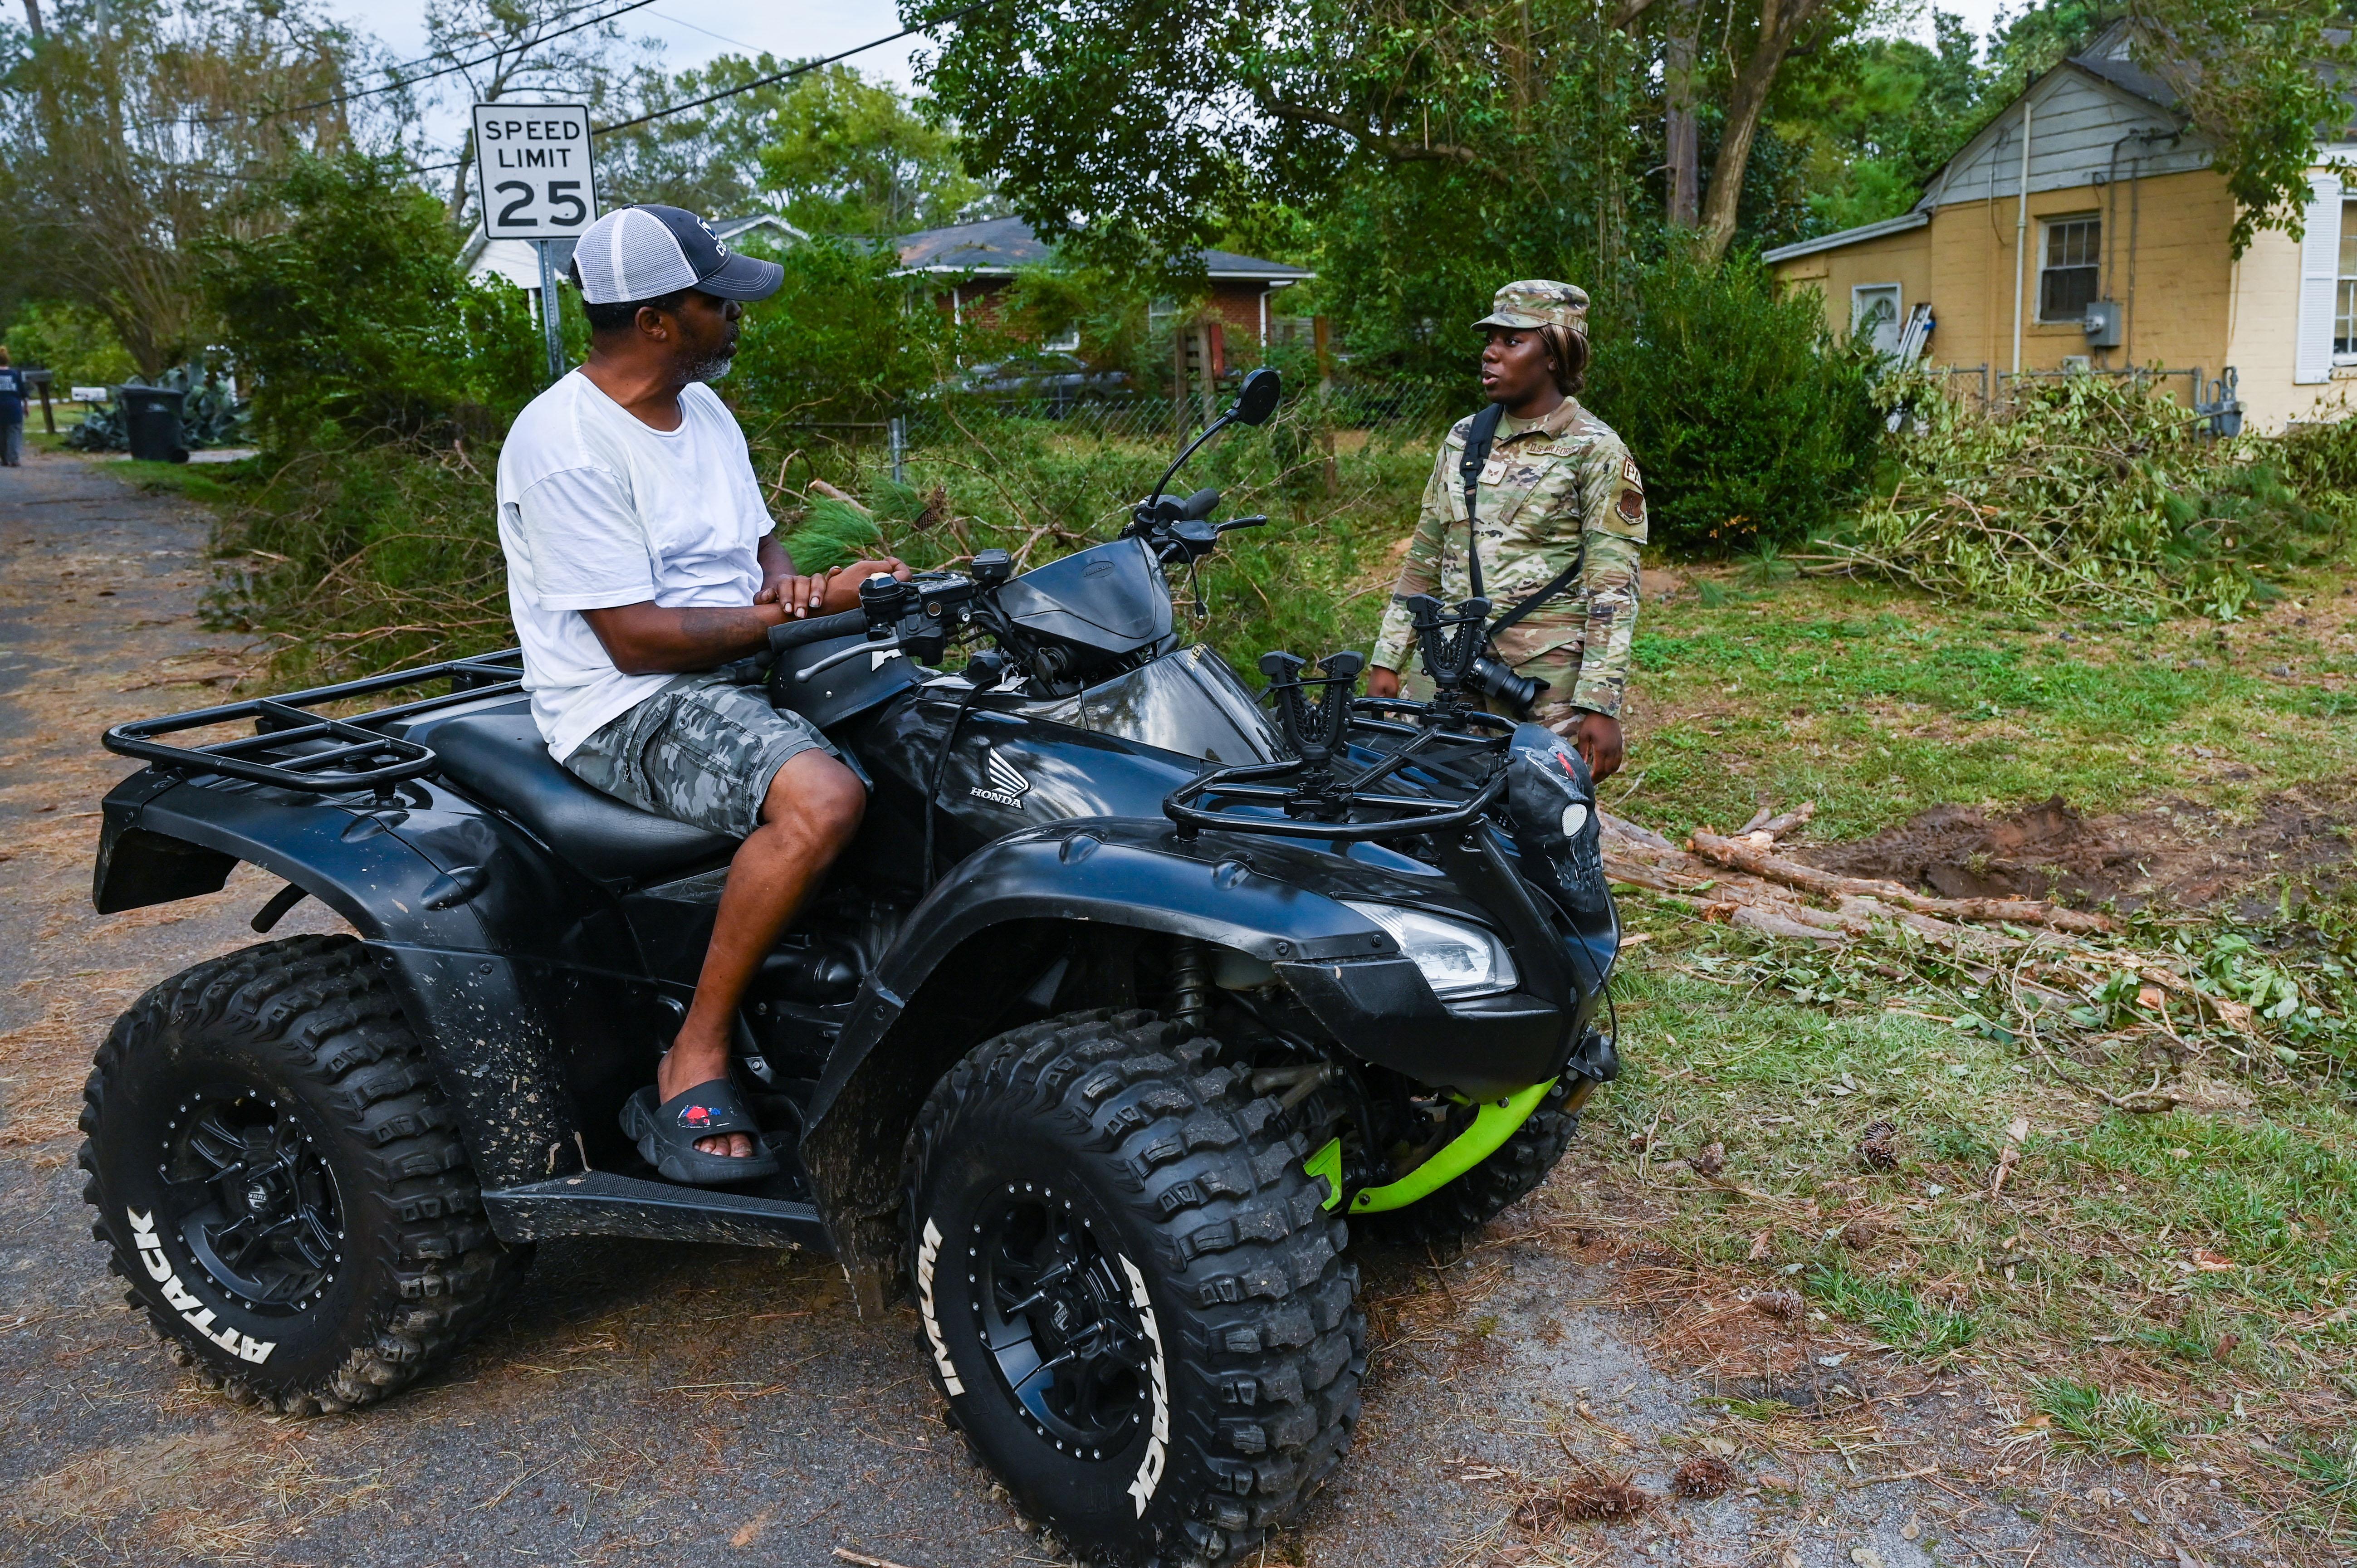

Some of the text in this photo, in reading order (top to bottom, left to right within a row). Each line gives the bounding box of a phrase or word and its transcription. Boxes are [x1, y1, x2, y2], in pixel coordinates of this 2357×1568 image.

[485, 120, 580, 141] SPEED
[498, 148, 572, 168] LIMIT
[494, 180, 587, 227] 25
[1544, 444, 1555, 452] AIR
[1555, 445, 1579, 455] FORC
[1626, 463, 1642, 487] PA
[1186, 643, 1208, 673] AIKENS
[969, 786, 1022, 809] HONDA
[127, 1207, 277, 1364] ATTACK
[1054, 1307, 1068, 1324] TUSK
[1118, 1252, 1169, 1519] ATTACK
